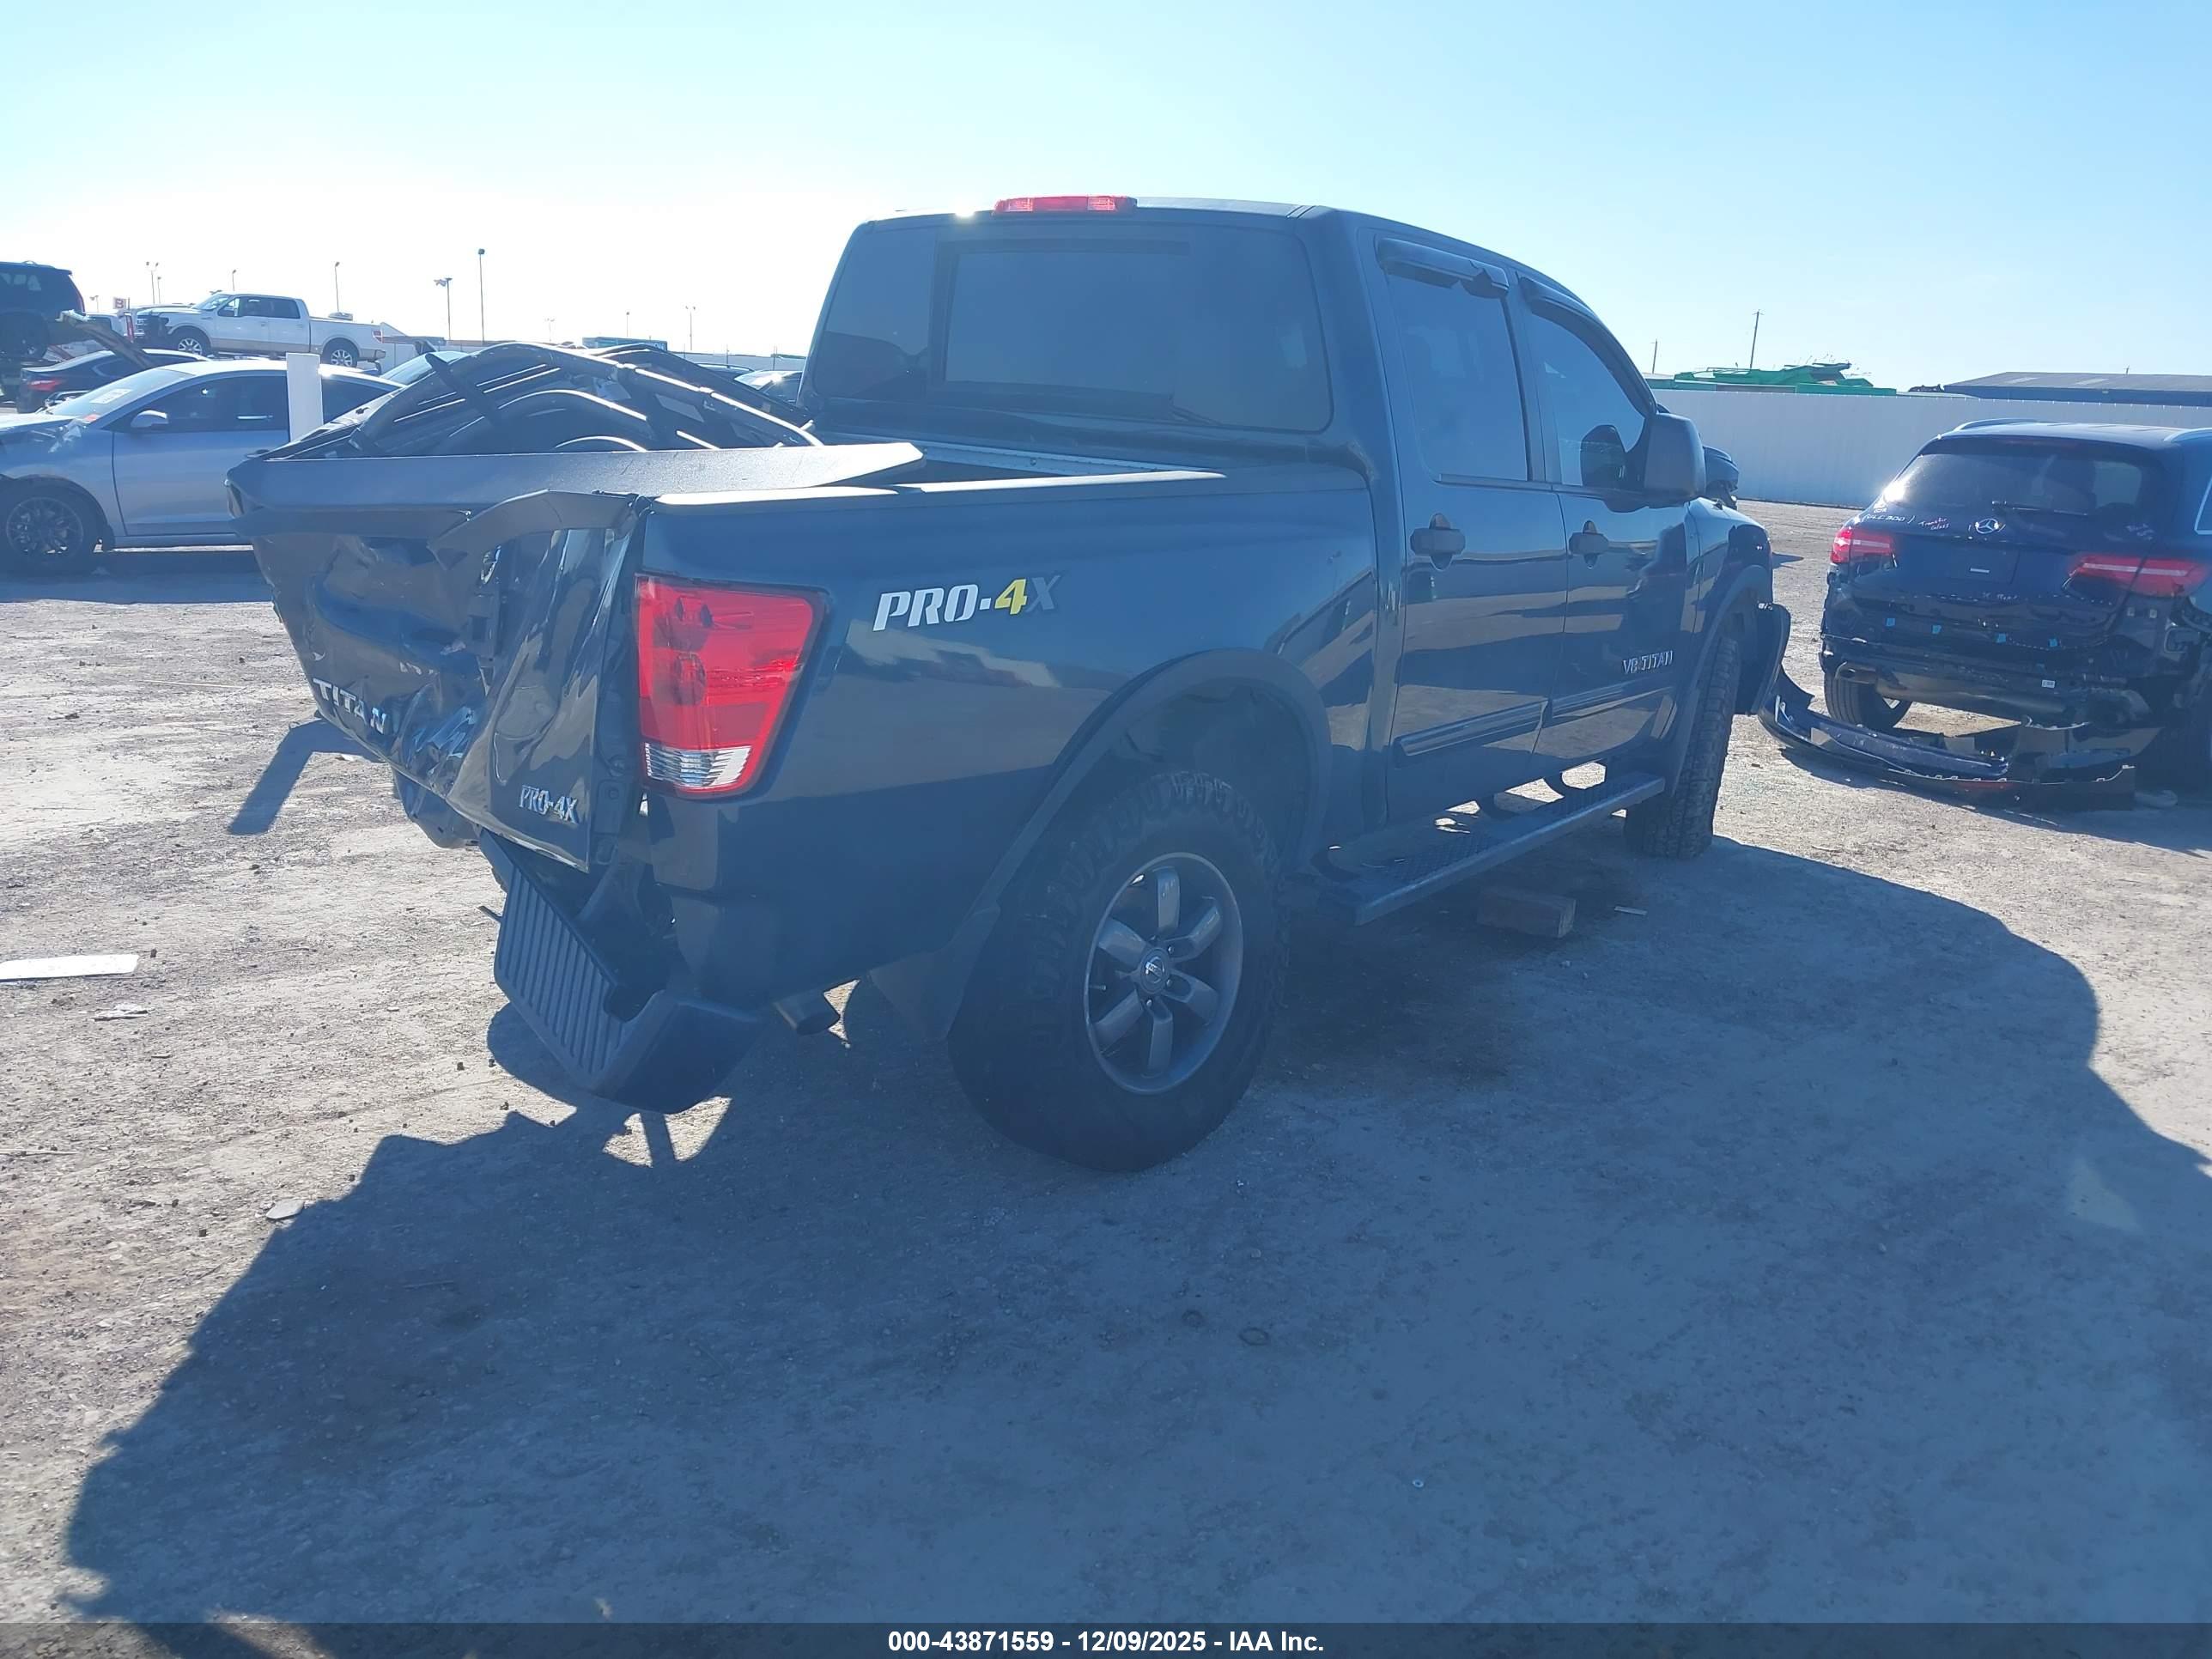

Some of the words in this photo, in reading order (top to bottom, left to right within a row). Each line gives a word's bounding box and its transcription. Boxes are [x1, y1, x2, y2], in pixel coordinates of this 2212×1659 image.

[872, 574, 1060, 631] PRO-4X
[313, 678, 386, 734] TITAN
[520, 784, 580, 824] PRO-4X
